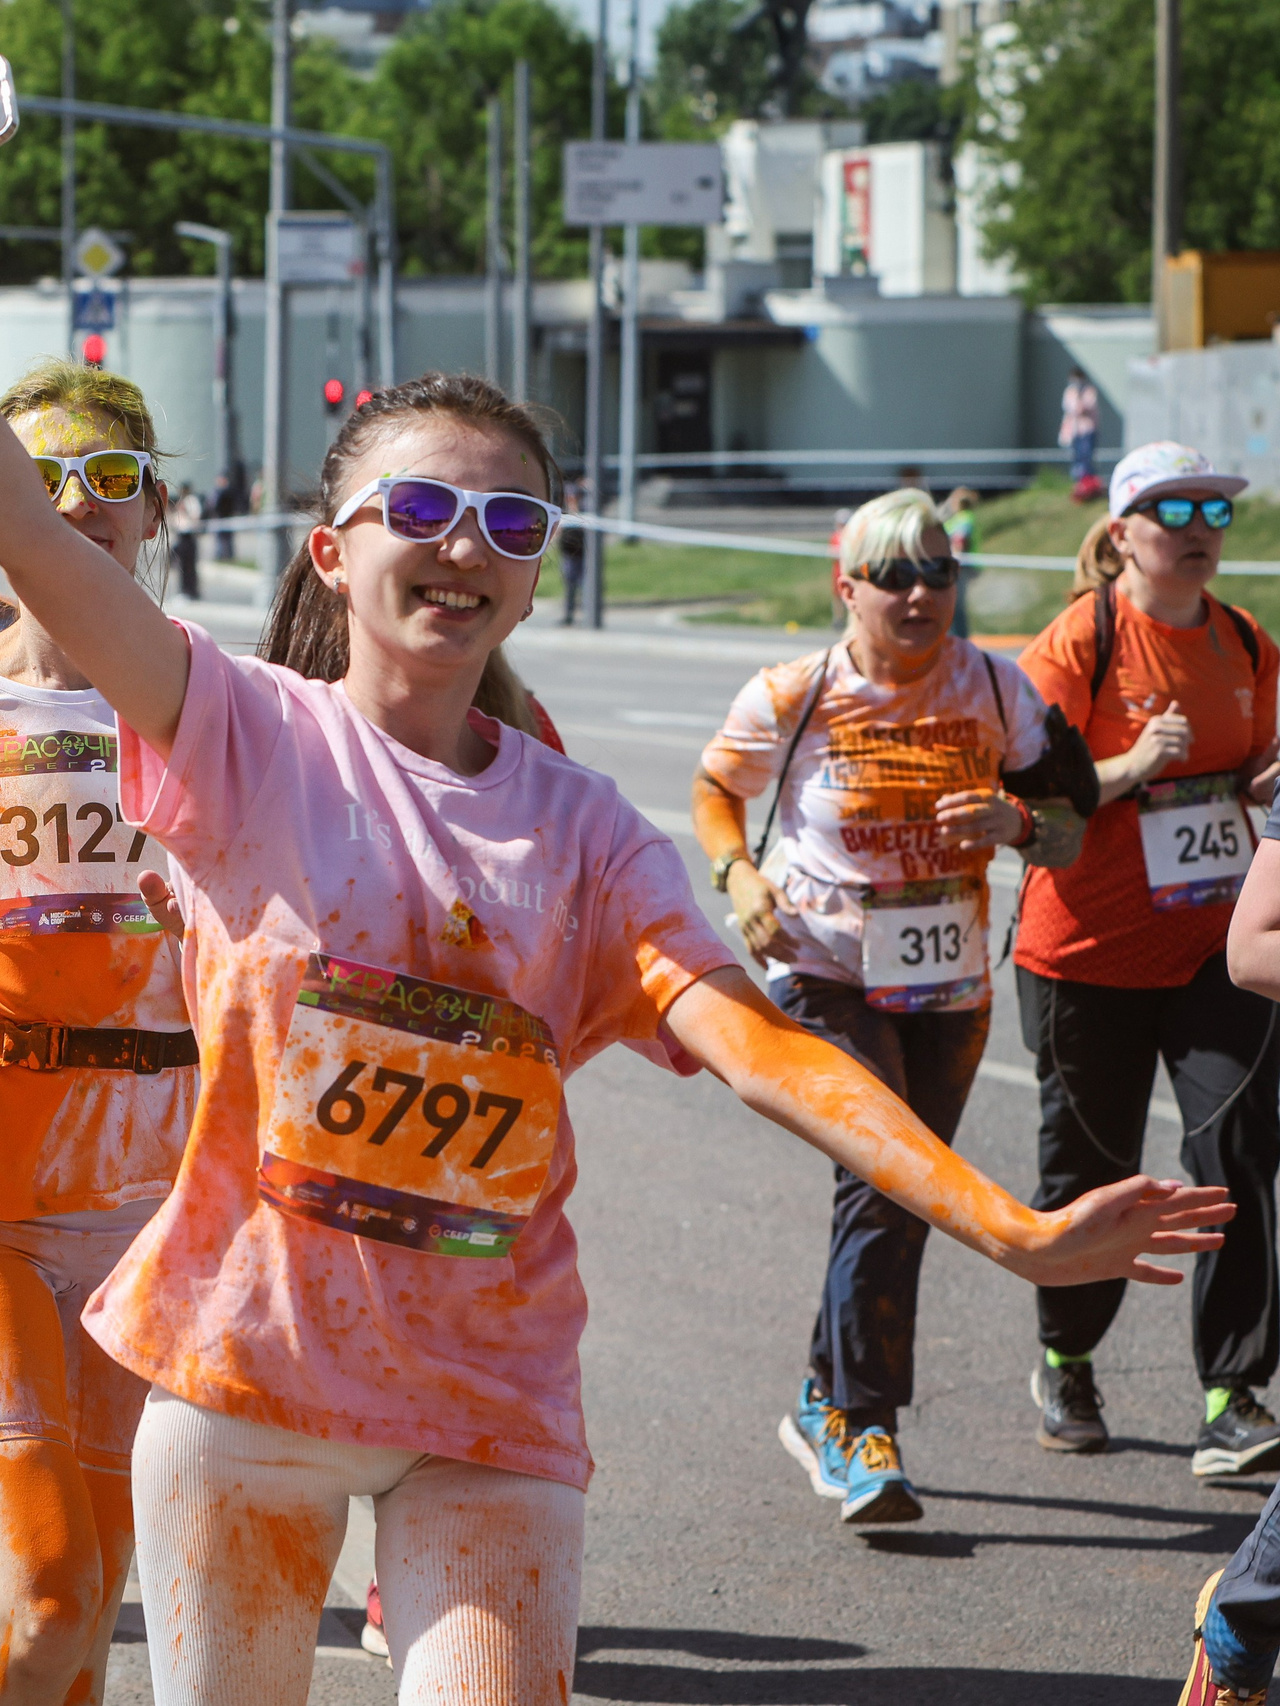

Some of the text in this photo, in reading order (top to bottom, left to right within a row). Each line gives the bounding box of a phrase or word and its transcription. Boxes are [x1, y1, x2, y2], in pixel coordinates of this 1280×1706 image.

[345, 802, 393, 850] It's
[452, 864, 547, 914] bout
[840, 822, 942, 853] ВМЕСТЕ
[1175, 819, 1238, 864] 245
[900, 922, 961, 966] 313
[317, 1059, 524, 1169] 6797
